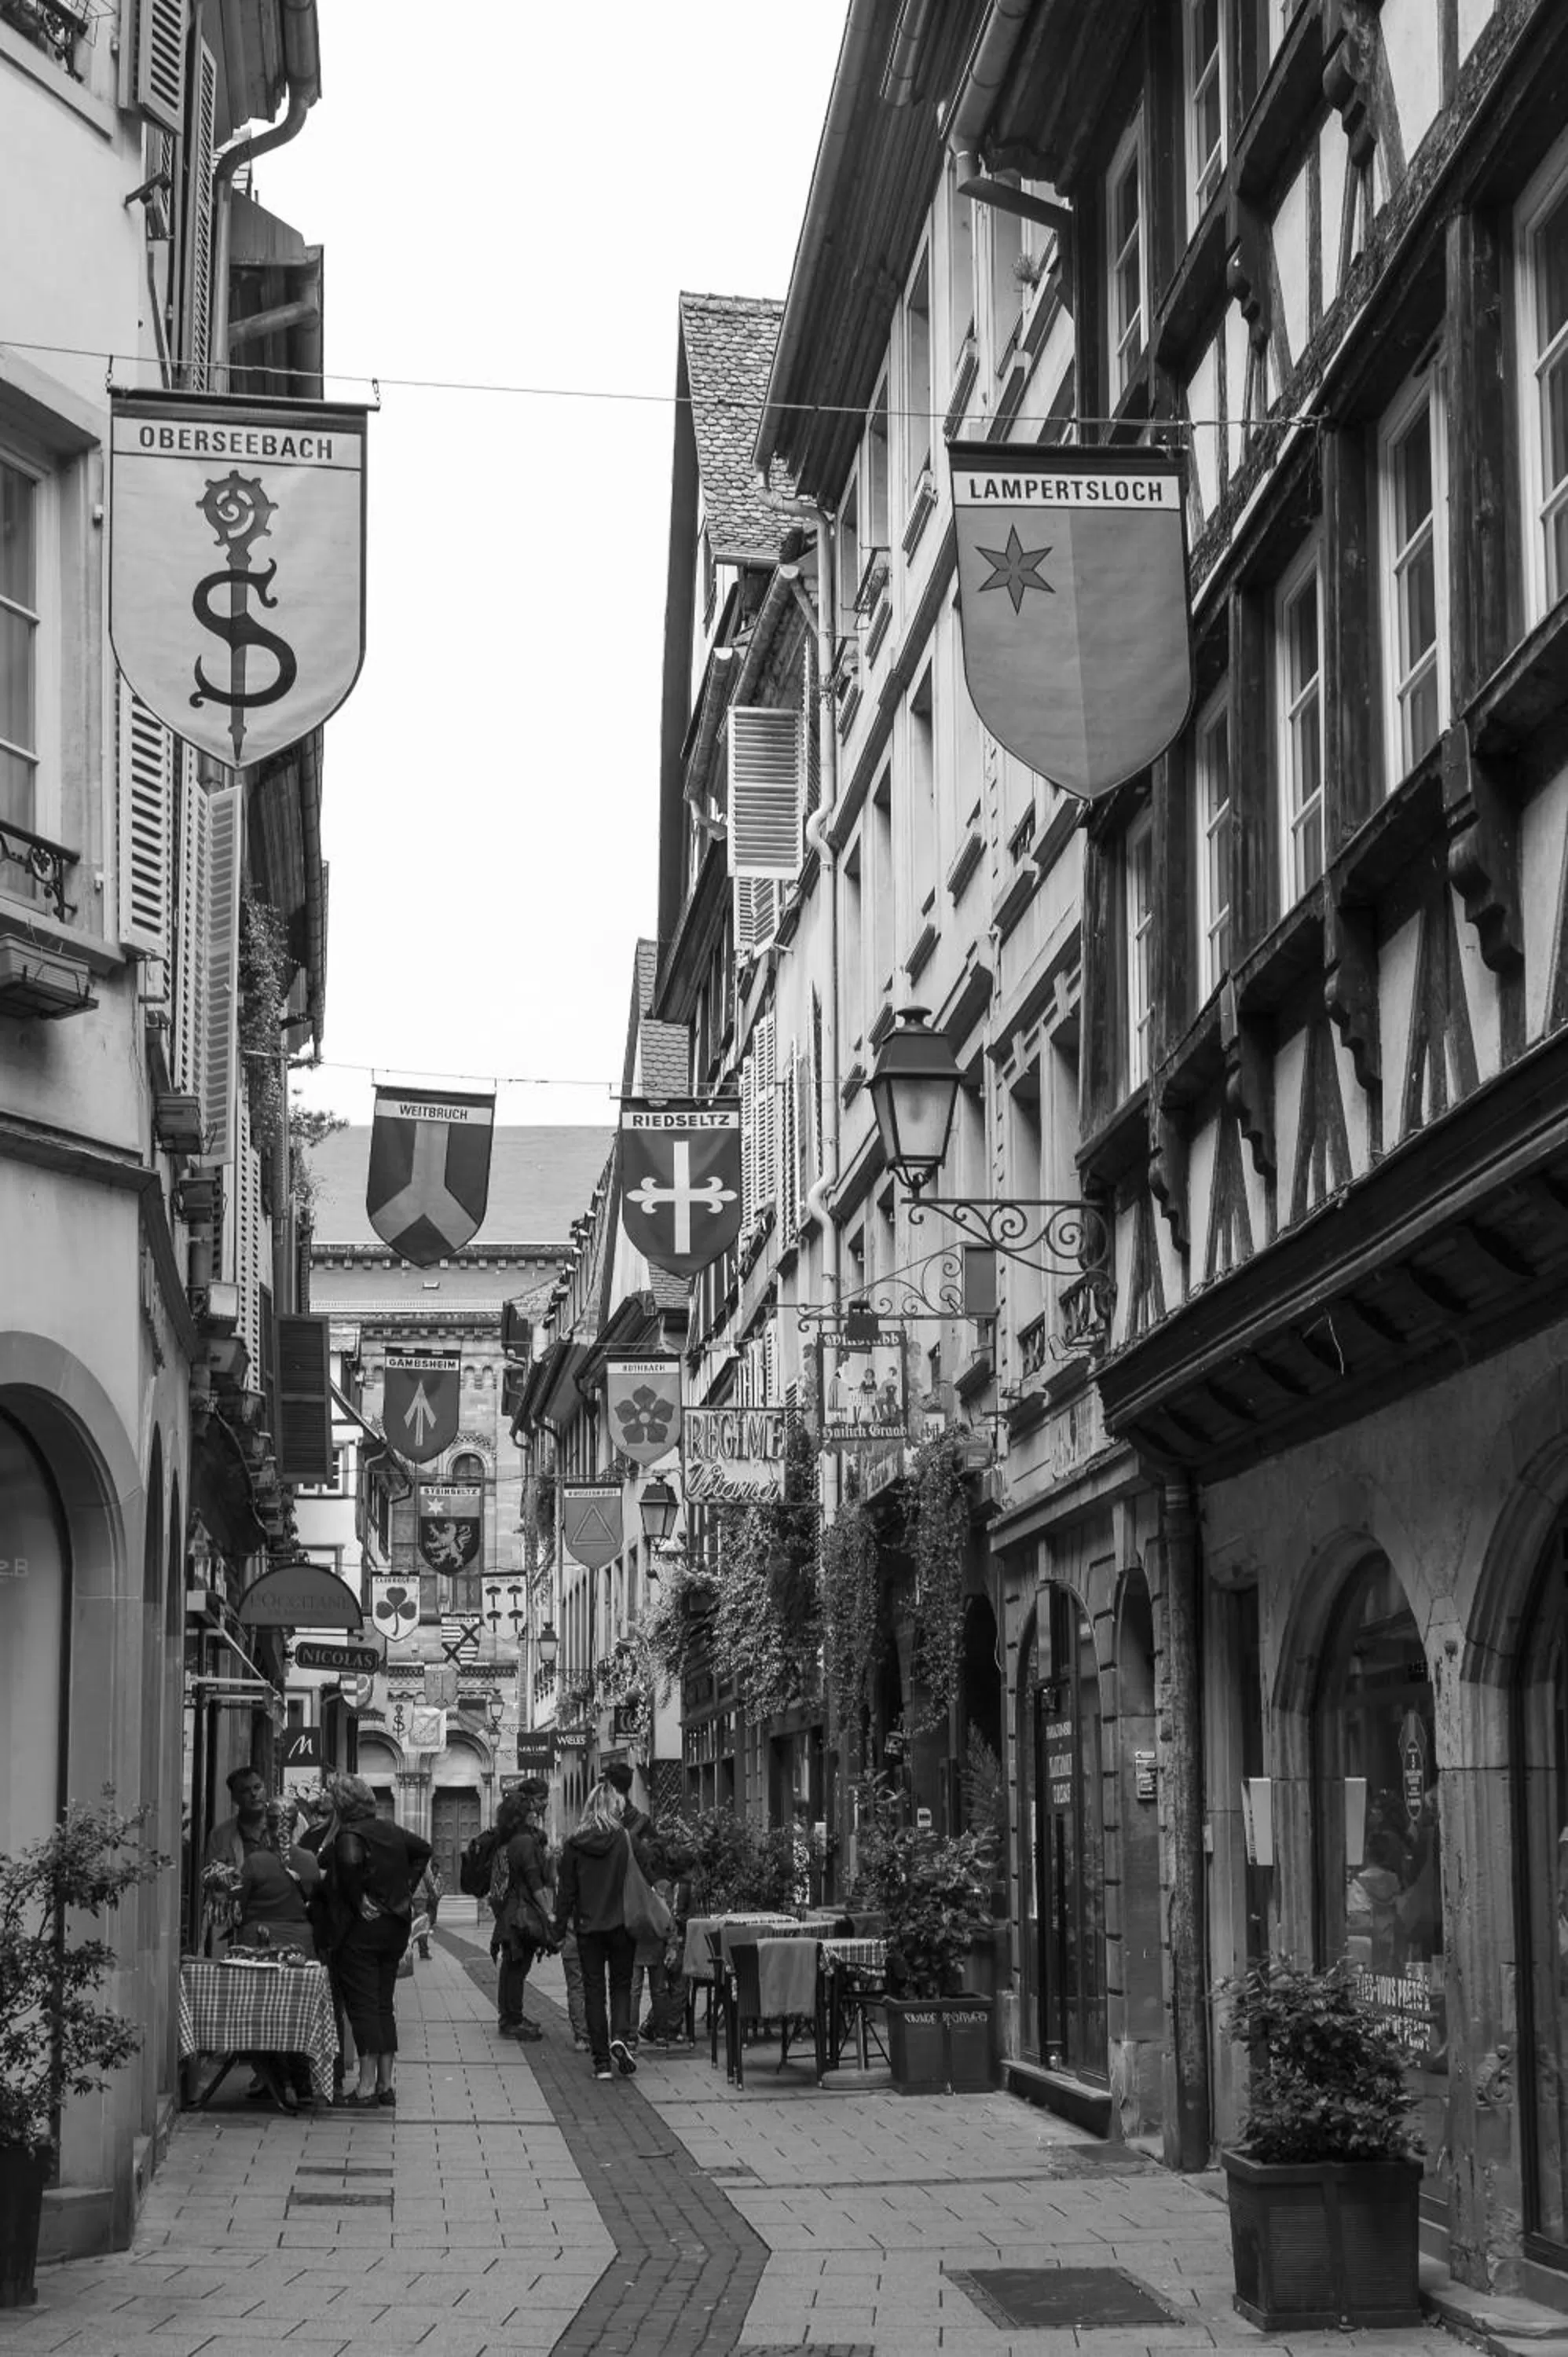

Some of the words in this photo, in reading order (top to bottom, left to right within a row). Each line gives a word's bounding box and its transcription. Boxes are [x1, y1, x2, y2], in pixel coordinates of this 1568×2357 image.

[139, 426, 333, 460] OBERSEEBACH
[969, 478, 1163, 502] LAMPERTSLOCH
[399, 1104, 468, 1120] WEITBRUCH
[632, 1114, 730, 1127] RIEDSELTZ
[389, 1358, 456, 1369] GAMBSHEIM
[302, 1648, 372, 1667] NICOLAS
